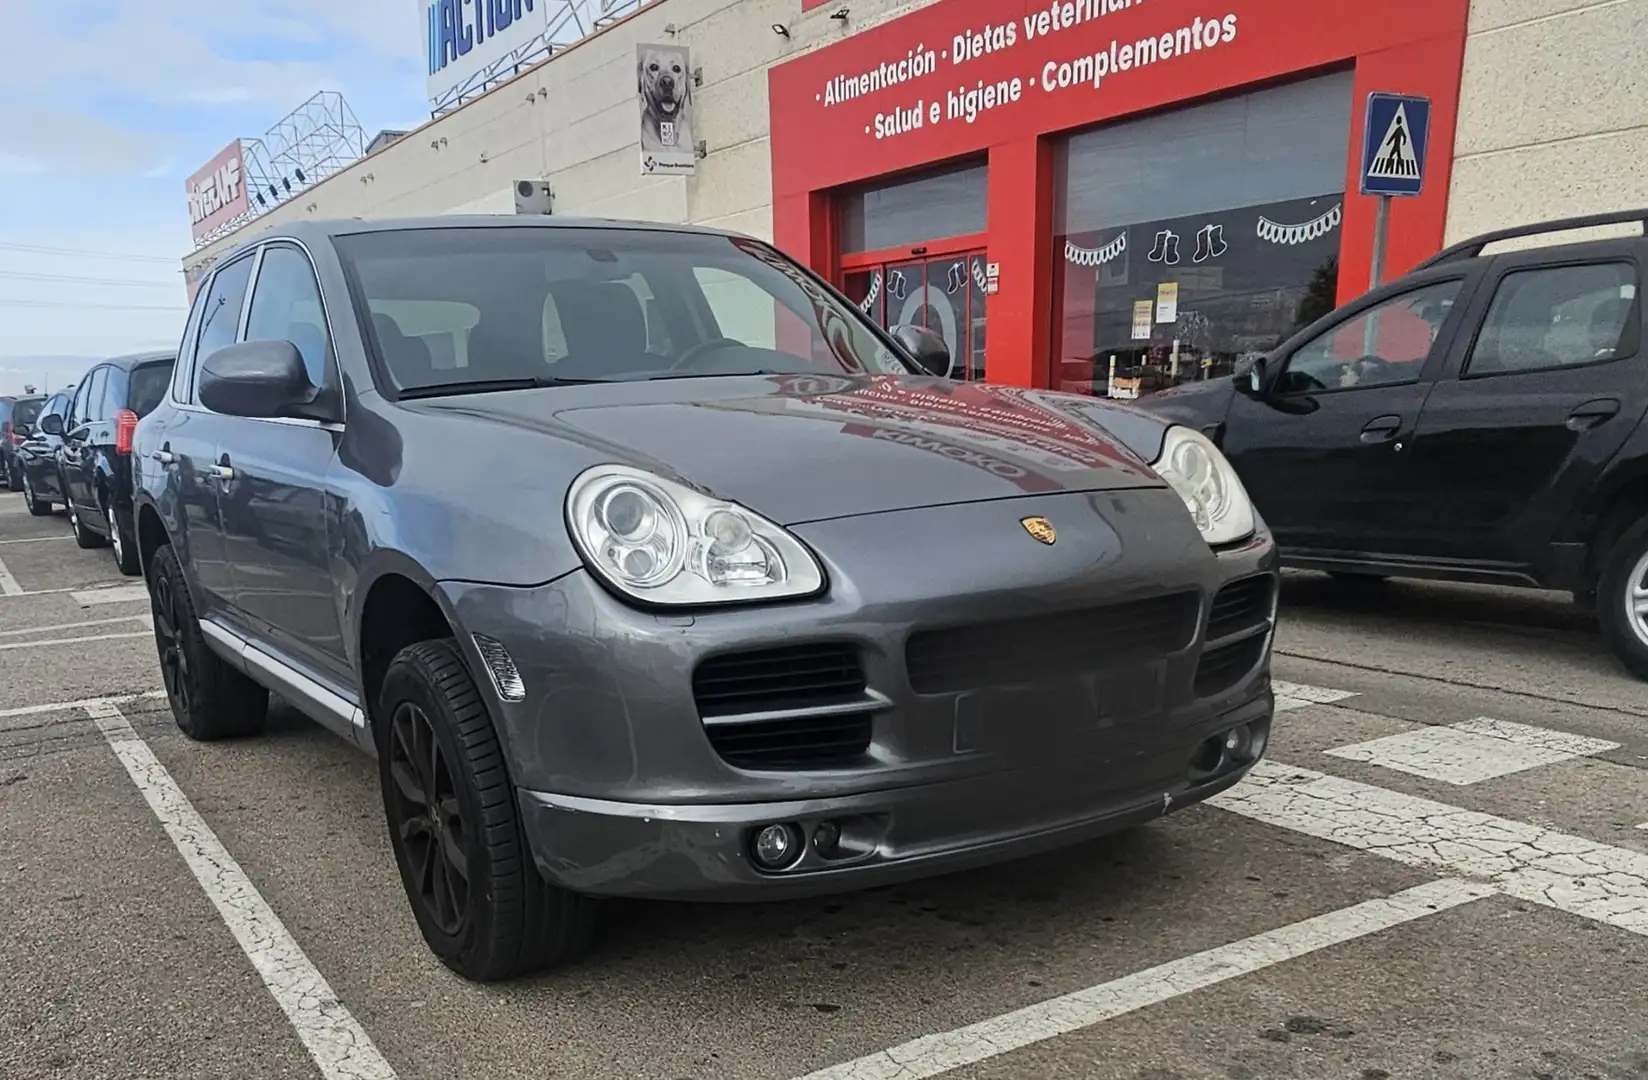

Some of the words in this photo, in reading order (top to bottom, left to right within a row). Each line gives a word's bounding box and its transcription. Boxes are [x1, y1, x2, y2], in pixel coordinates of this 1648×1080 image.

[823, 44, 936, 107] Alimentación
[952, 21, 1017, 65] Dietas
[875, 100, 923, 139] Salud
[929, 102, 941, 125] e
[947, 78, 1022, 124] higiene
[1041, 14, 1237, 92] Complementos
